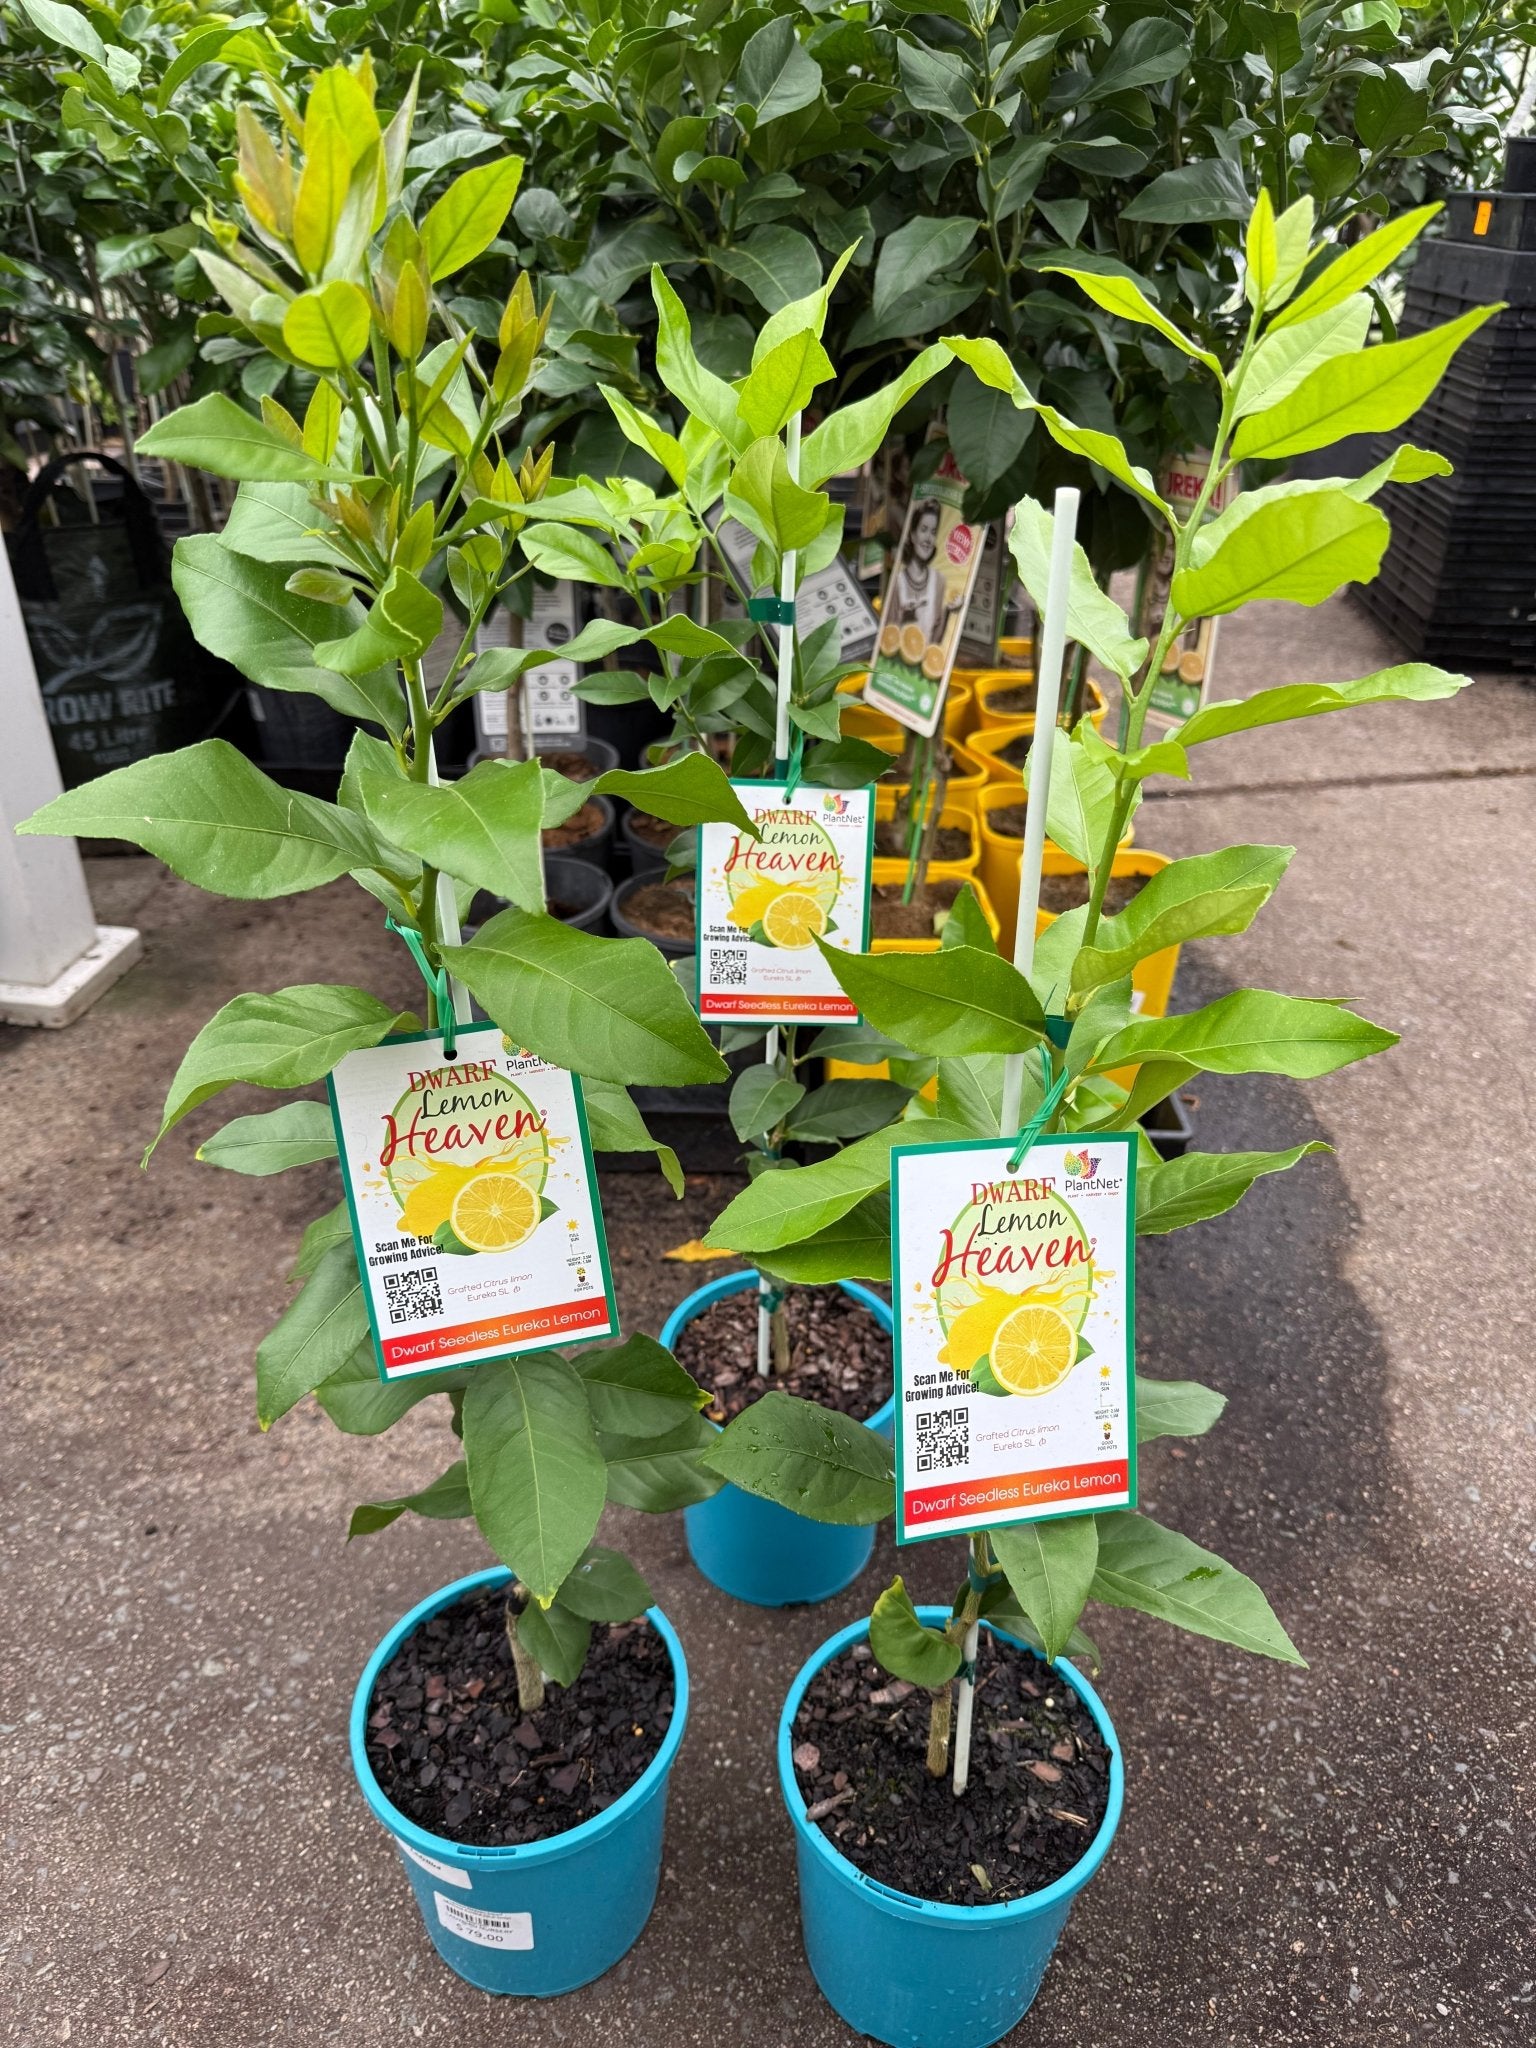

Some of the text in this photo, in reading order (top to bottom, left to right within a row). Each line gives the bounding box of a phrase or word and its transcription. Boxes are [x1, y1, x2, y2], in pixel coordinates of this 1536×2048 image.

[754, 809, 817, 826] DWARF
[760, 824, 825, 845] Lemon
[704, 934, 730, 942] Growing
[706, 999, 854, 1012] Dwarf Seedless Eureka Lemon
[407, 1059, 497, 1092] DWARF
[420, 1088, 514, 1120] Lemon
[970, 1176, 1056, 1206] DWARF
[978, 1203, 1067, 1237] Lemon
[376, 1234, 433, 1253] Scan Me For
[368, 1244, 444, 1267] Growing Advice!
[448, 1274, 533, 1295] Grafted Citrus limon
[467, 1288, 510, 1302] Eureka SL
[392, 1308, 600, 1359] Dwarf Seedless Eureka Lemon
[914, 1368, 970, 1387] Scan Me For
[905, 1380, 980, 1402] Growing Advice!
[976, 1424, 1060, 1442] Grafted Citrus limon
[993, 1438, 1036, 1452] Eureka SL
[912, 1472, 1121, 1515] Dwarf Seedless Eureka Lemon
